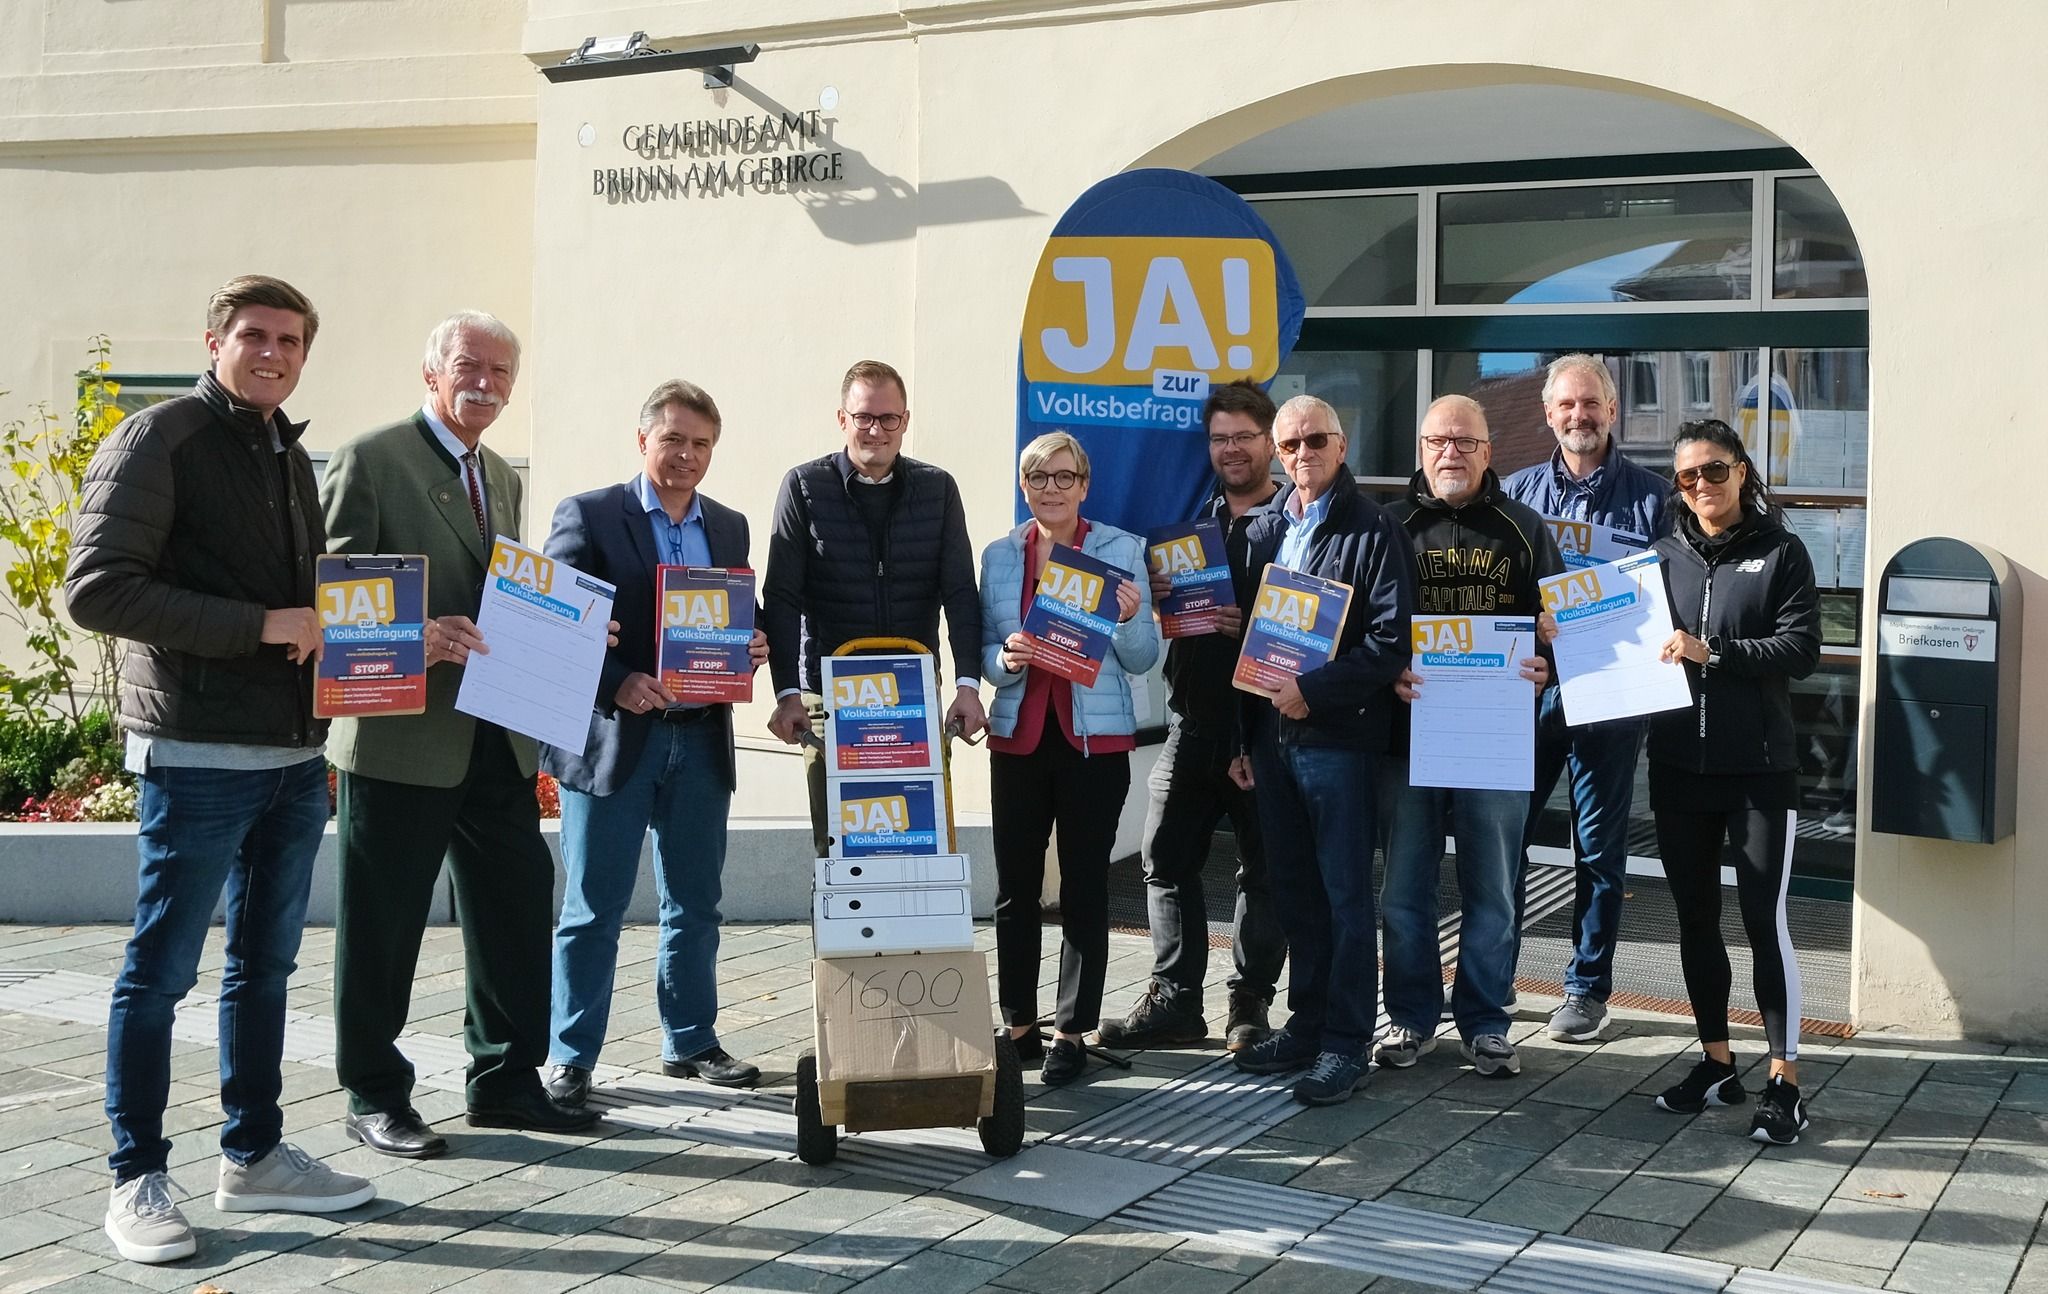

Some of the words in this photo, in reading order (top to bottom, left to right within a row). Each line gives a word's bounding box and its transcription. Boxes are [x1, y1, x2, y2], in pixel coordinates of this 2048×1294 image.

[622, 109, 820, 152] GEMEINDEAMT
[593, 164, 674, 195] BRUNN
[685, 160, 727, 189] AM
[737, 152, 843, 186] GEBIRGE
[1040, 256, 1253, 374] JA!
[1162, 374, 1200, 393] zur
[1037, 391, 1203, 429] Volksbefragu
[496, 548, 549, 589] JA!
[1154, 540, 1200, 575] JA!
[1416, 548, 1511, 586] IENNA
[1041, 567, 1097, 607] JA!
[1171, 569, 1228, 585] lksbefragung
[1548, 574, 1596, 610] JA!
[321, 584, 388, 624] JA!
[502, 581, 576, 620] Volksbefragung
[667, 595, 722, 625] JA!
[1185, 599, 1210, 609] STOPP
[1260, 590, 1312, 626] JA!
[1420, 584, 1496, 612] CAPITALS
[1560, 596, 1631, 619] Volksbefragung
[1041, 598, 1112, 634] Volksbefragung
[330, 628, 419, 641] Volksbefragung
[672, 629, 750, 643] Volksbefragung
[1050, 633, 1079, 648] STOPP
[1260, 620, 1328, 652] Volksbefragung
[1417, 622, 1468, 651] JA!
[1899, 633, 1960, 649] Briefkasten
[354, 664, 389, 674] STOPP
[692, 661, 723, 669] STOPP
[1269, 654, 1297, 667] STOPP
[1427, 655, 1500, 666] Volksbefragung
[836, 677, 892, 707] JA!
[842, 707, 922, 718] Volksbefragung
[867, 735, 897, 743] STOPP
[843, 800, 902, 833] JA!
[850, 833, 933, 845] Volksbefragung
[835, 967, 963, 1015] 1600
